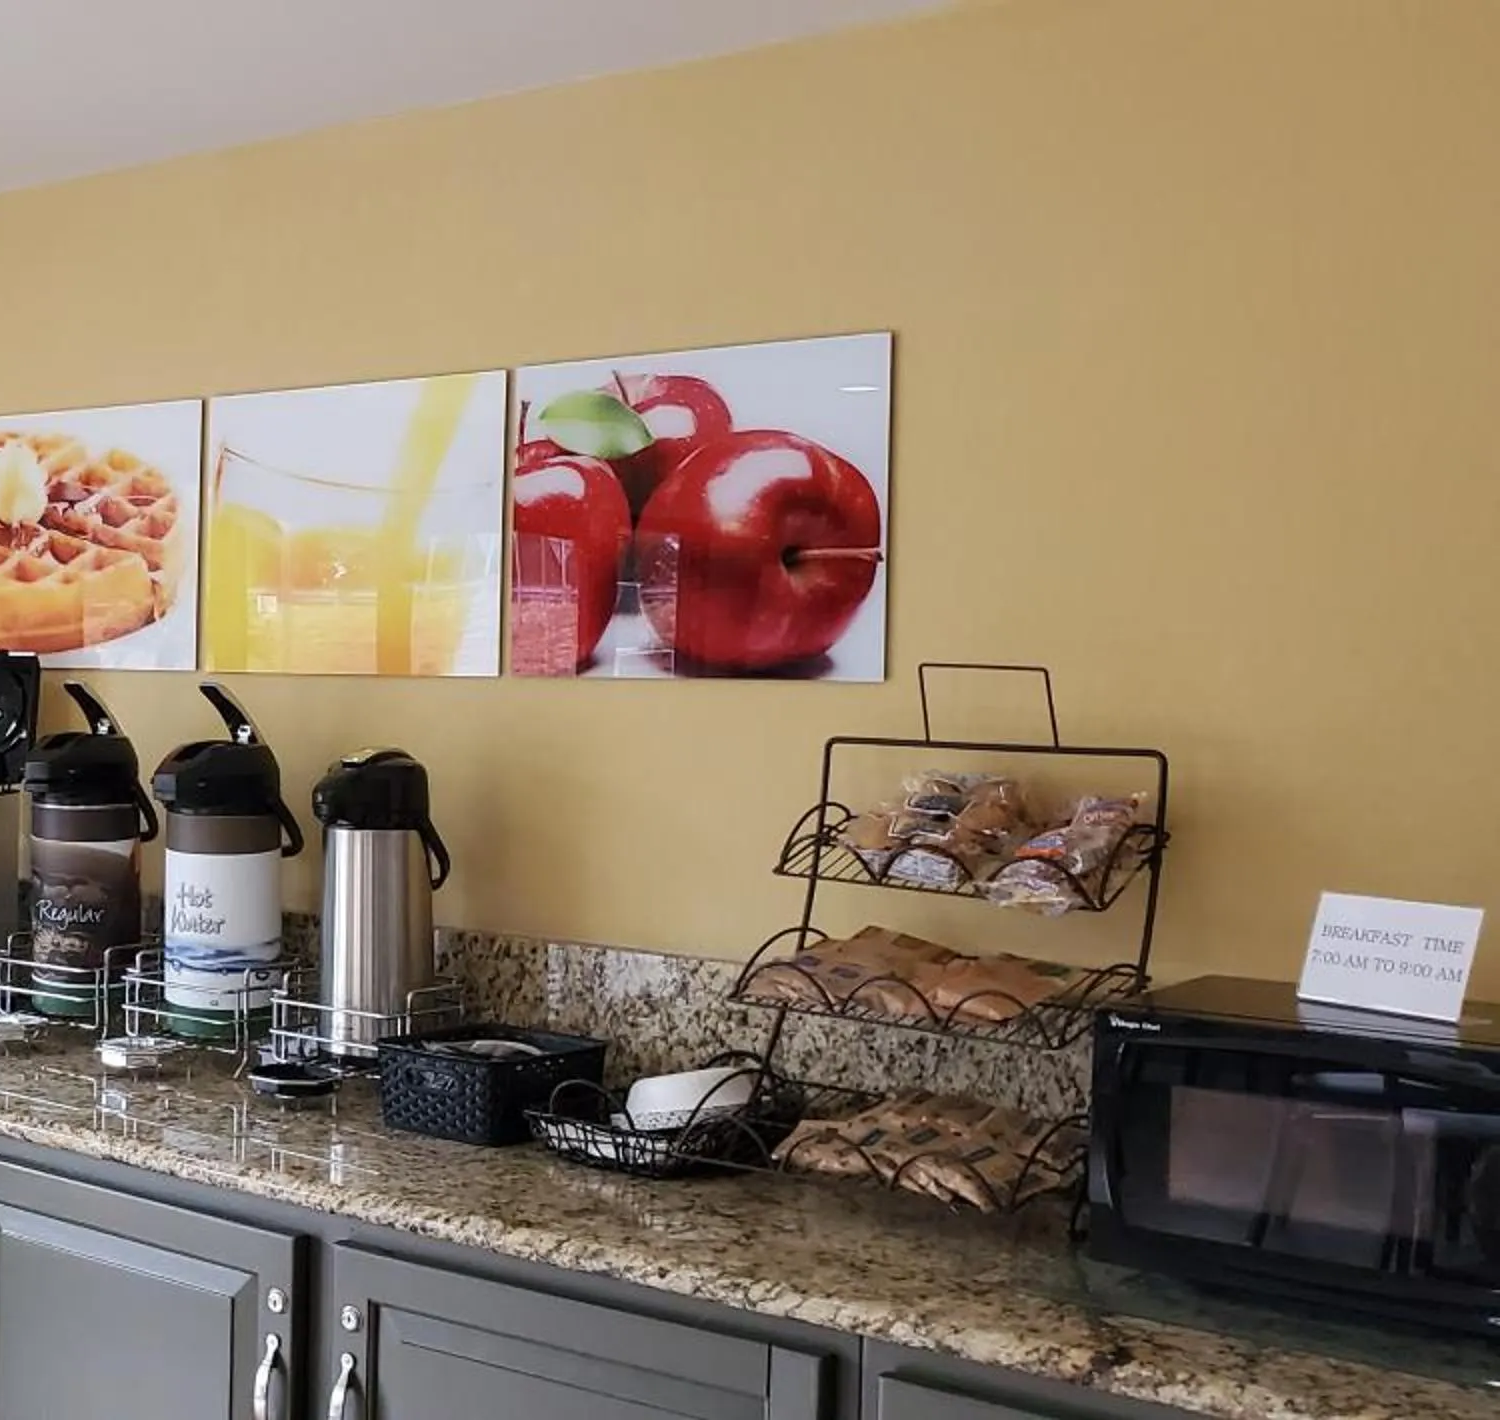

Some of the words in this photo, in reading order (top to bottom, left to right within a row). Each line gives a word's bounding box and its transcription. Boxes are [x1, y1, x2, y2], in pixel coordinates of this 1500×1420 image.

[176, 882, 213, 909] Hot
[35, 898, 106, 931] Regular
[170, 904, 227, 935] Water
[1320, 923, 1414, 948] BREAKFAST
[1423, 935, 1466, 954] TIME
[1342, 953, 1370, 971] AM
[1373, 956, 1396, 974] TO
[1397, 959, 1434, 979] 9:00
[1434, 965, 1464, 984] AM
